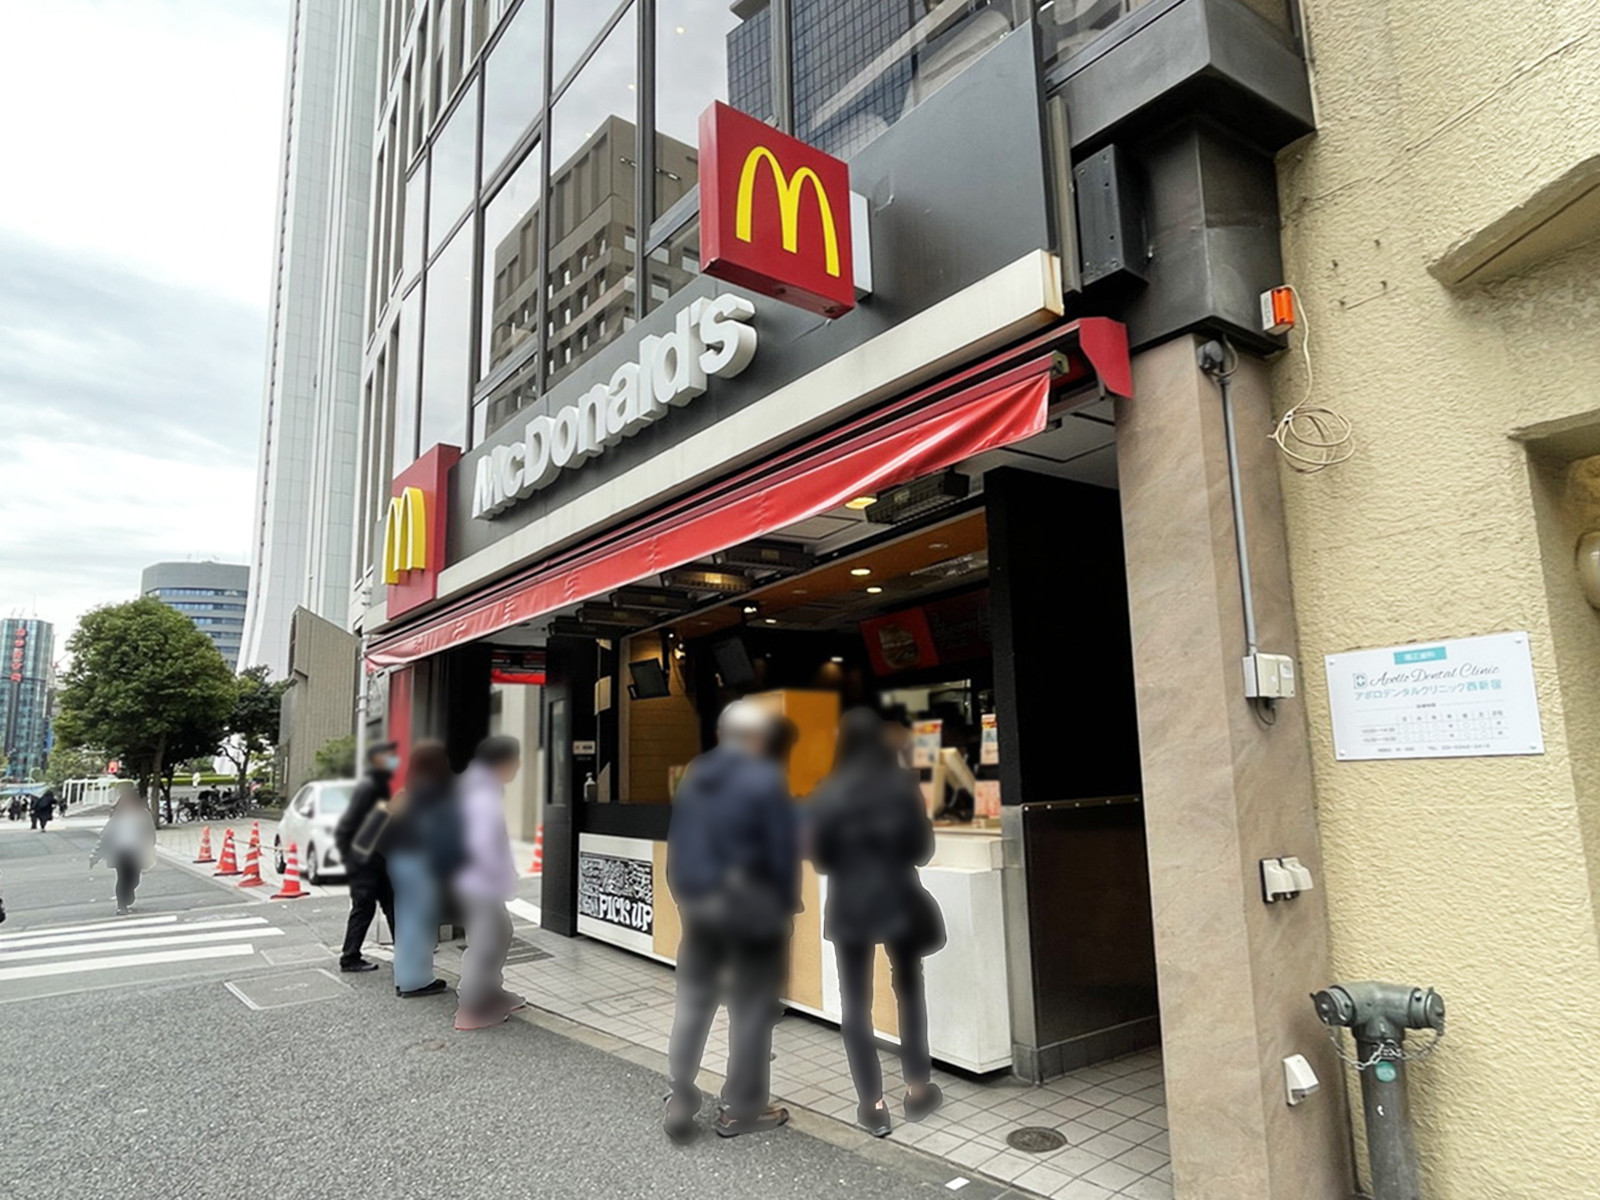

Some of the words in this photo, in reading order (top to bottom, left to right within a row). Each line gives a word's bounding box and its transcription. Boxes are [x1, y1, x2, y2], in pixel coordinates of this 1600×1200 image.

[472, 293, 758, 520] McDonald's
[1411, 667, 1456, 683] Dental
[1458, 662, 1500, 678] Clinic
[599, 894, 631, 926] PICK
[631, 902, 653, 932] UP
